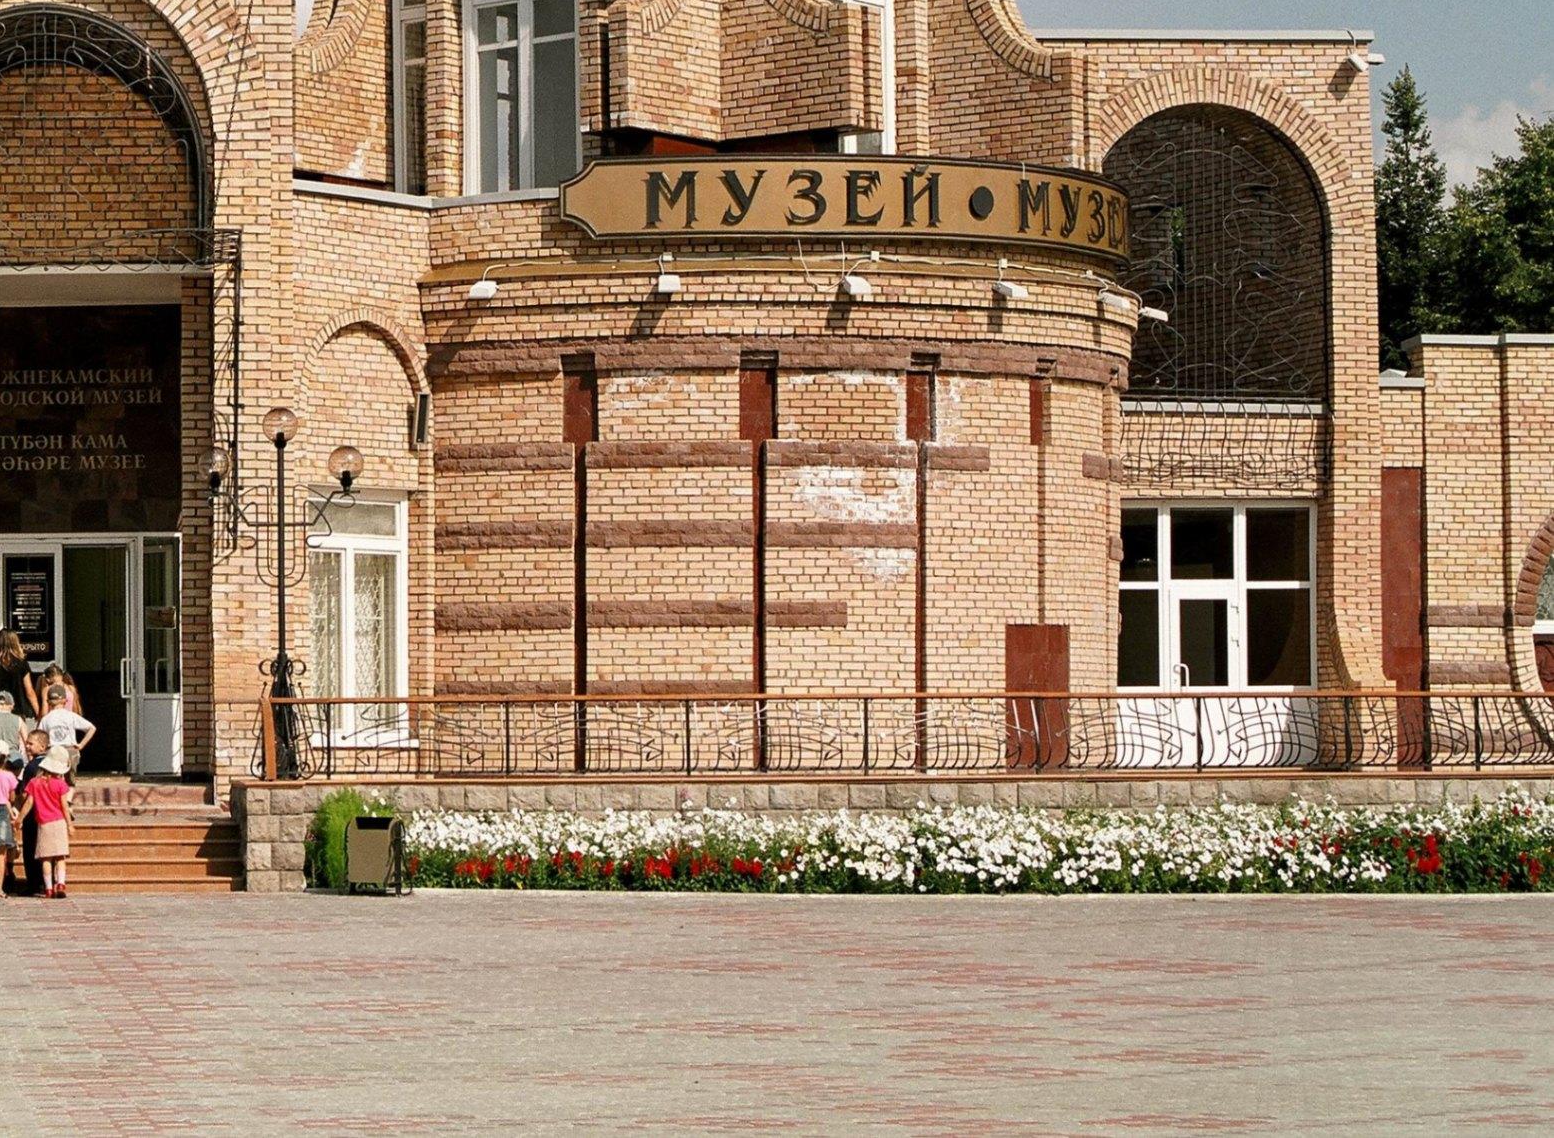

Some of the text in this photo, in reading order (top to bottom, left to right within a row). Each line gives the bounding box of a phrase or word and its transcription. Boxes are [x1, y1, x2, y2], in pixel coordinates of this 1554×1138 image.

[641, 165, 1126, 251] МУЗЕЙ МУЗЕ
[92, 386, 163, 405] МУЗЕЙ
[71, 434, 128, 449] КАМА
[79, 454, 146, 469] МУЗЕЕ
